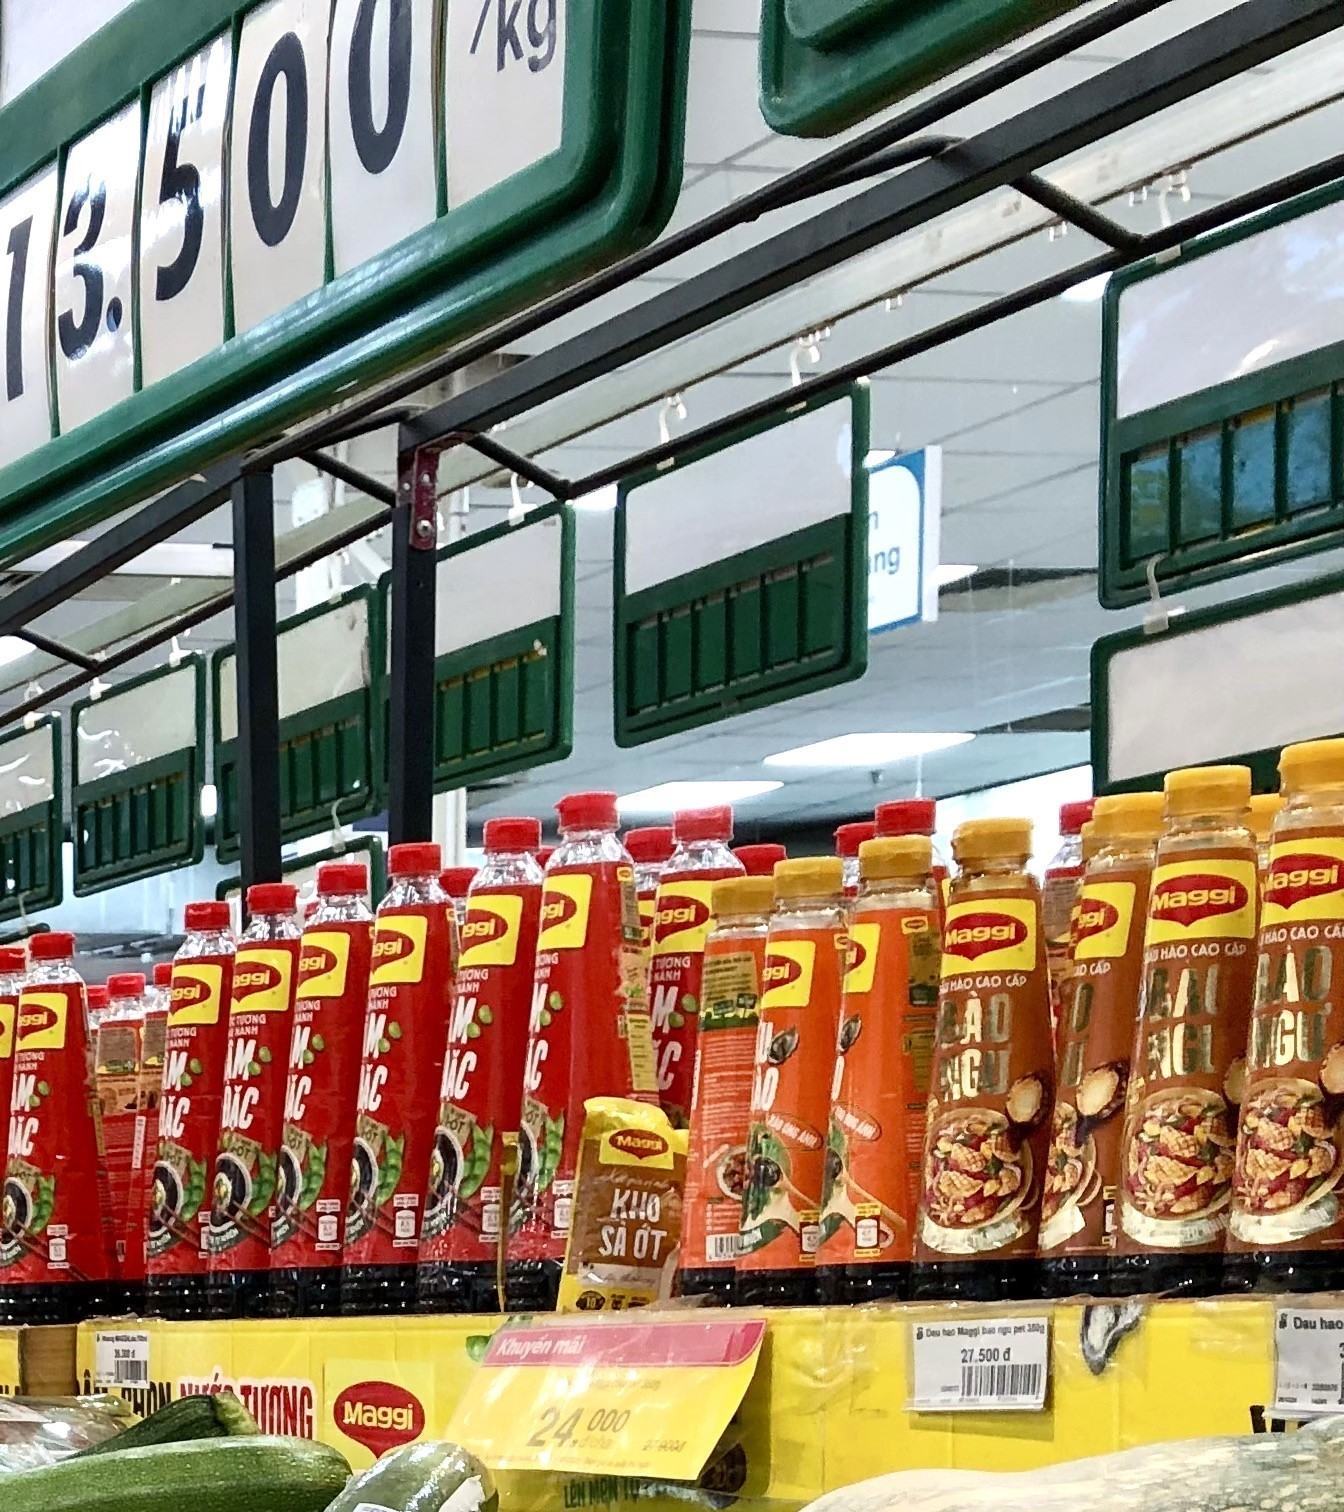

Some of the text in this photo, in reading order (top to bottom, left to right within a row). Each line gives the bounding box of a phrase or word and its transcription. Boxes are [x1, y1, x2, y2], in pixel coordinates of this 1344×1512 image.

[1190, 941, 1220, 958] CAO
[975, 974, 1002, 990] CAO
[610, 1187, 661, 1224] KHO
[1293, 1316, 1318, 1331] Dau
[960, 1347, 1002, 1364] 27.500
[343, 1400, 415, 1434] Maggi
